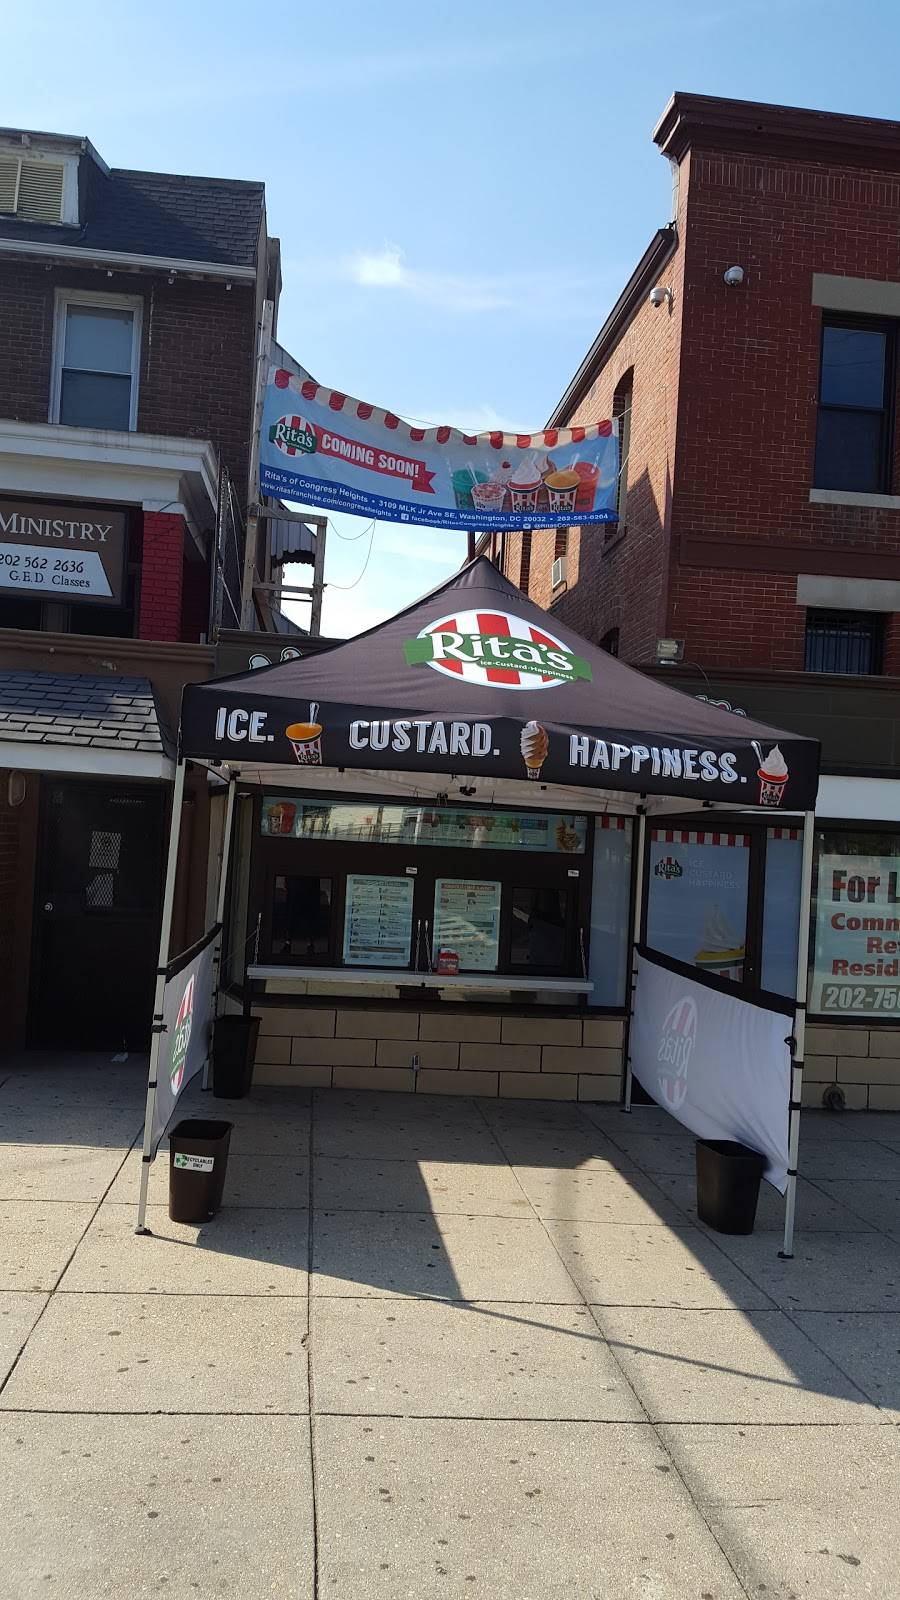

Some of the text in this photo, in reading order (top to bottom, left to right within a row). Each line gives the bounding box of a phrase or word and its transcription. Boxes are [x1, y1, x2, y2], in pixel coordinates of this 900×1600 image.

[275, 423, 313, 448] Rita's
[321, 433, 375, 466] COMING
[377, 454, 420, 478] SOON!
[264, 470, 288, 483] Rita's
[299, 479, 338, 494] Congress
[340, 487, 369, 503] Heights
[398, 504, 416, 513] MLK
[427, 509, 443, 517] Ave
[0, 553, 84, 574] 202 562 2636
[9, 570, 91, 588] G.E.D. Classes
[429, 631, 574, 671] Rita's
[215, 706, 748, 784] ICE. CUSTARD. HAPPINESS.
[832, 869, 881, 904] For
[832, 959, 899, 977] Resid
